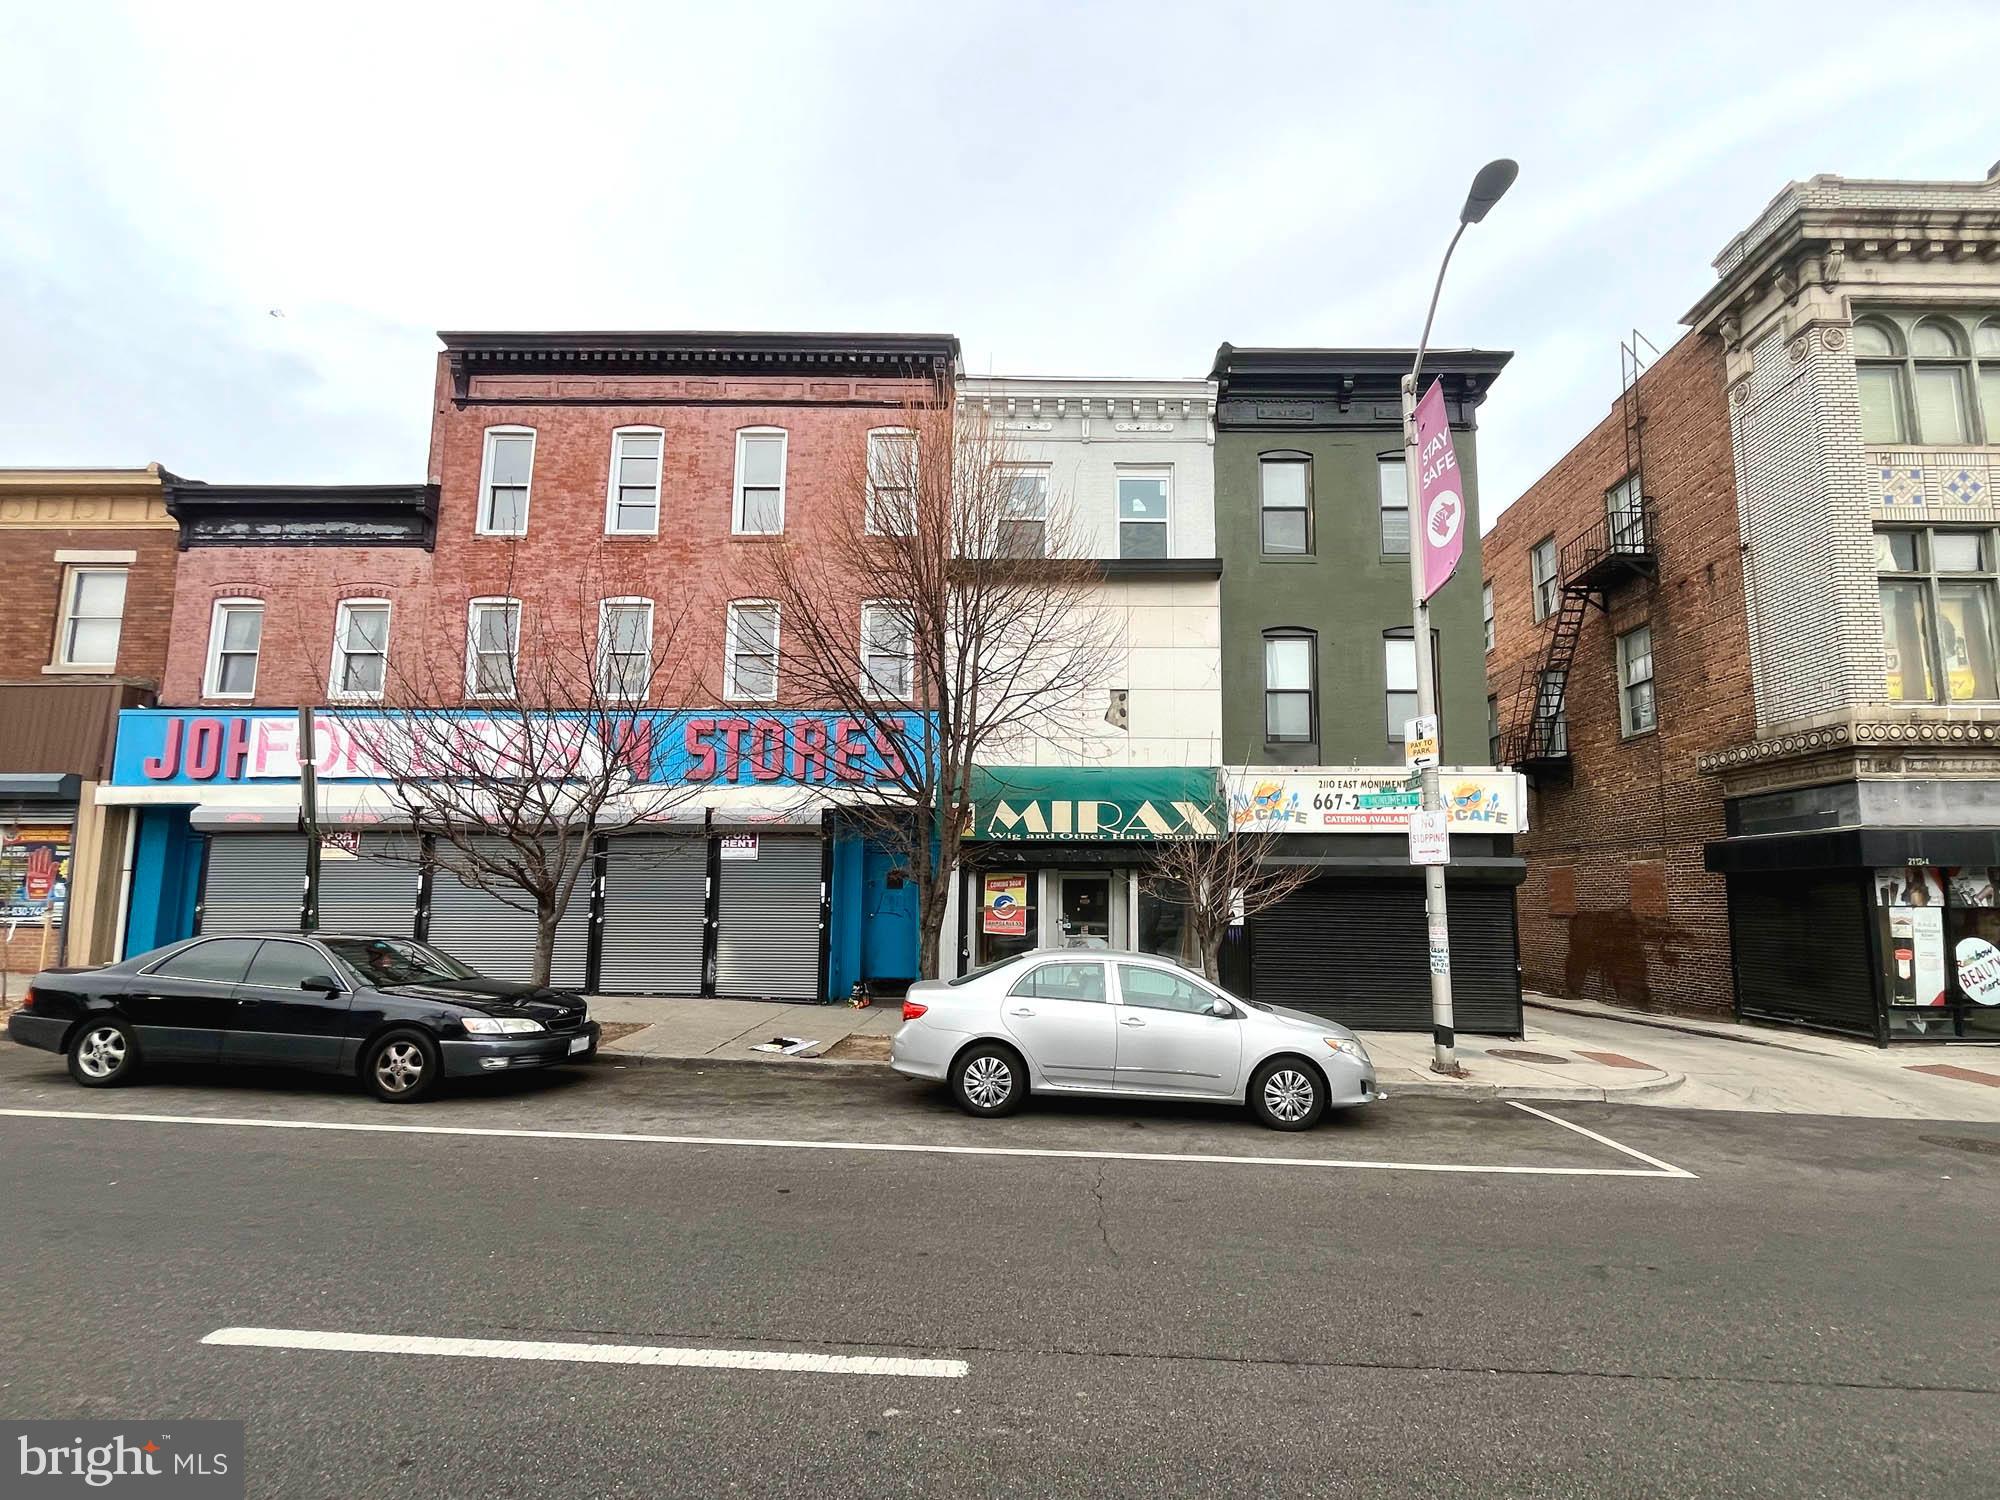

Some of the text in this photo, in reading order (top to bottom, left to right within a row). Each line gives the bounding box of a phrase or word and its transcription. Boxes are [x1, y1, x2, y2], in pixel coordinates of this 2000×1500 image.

[1422, 427, 1448, 466] STAY
[1422, 450, 1456, 490] SAFE
[256, 719, 388, 774] FOR
[684, 719, 905, 782] STORES
[1413, 747, 1431, 756] PARK
[1319, 780, 1335, 789] 2110
[1338, 780, 1357, 789] EAST
[1361, 780, 1406, 790] MONUMENT
[987, 800, 1221, 834] MIRAX
[1255, 808, 1308, 825] CAFE
[1325, 816, 1409, 824] CATERING AVAILABL
[1455, 809, 1509, 825] CAFE
[721, 839, 755, 848] RENT
[988, 832, 1021, 841] Wig
[1026, 832, 1056, 840] and
[1059, 832, 1107, 840] Other
[1112, 832, 1148, 840] Hair
